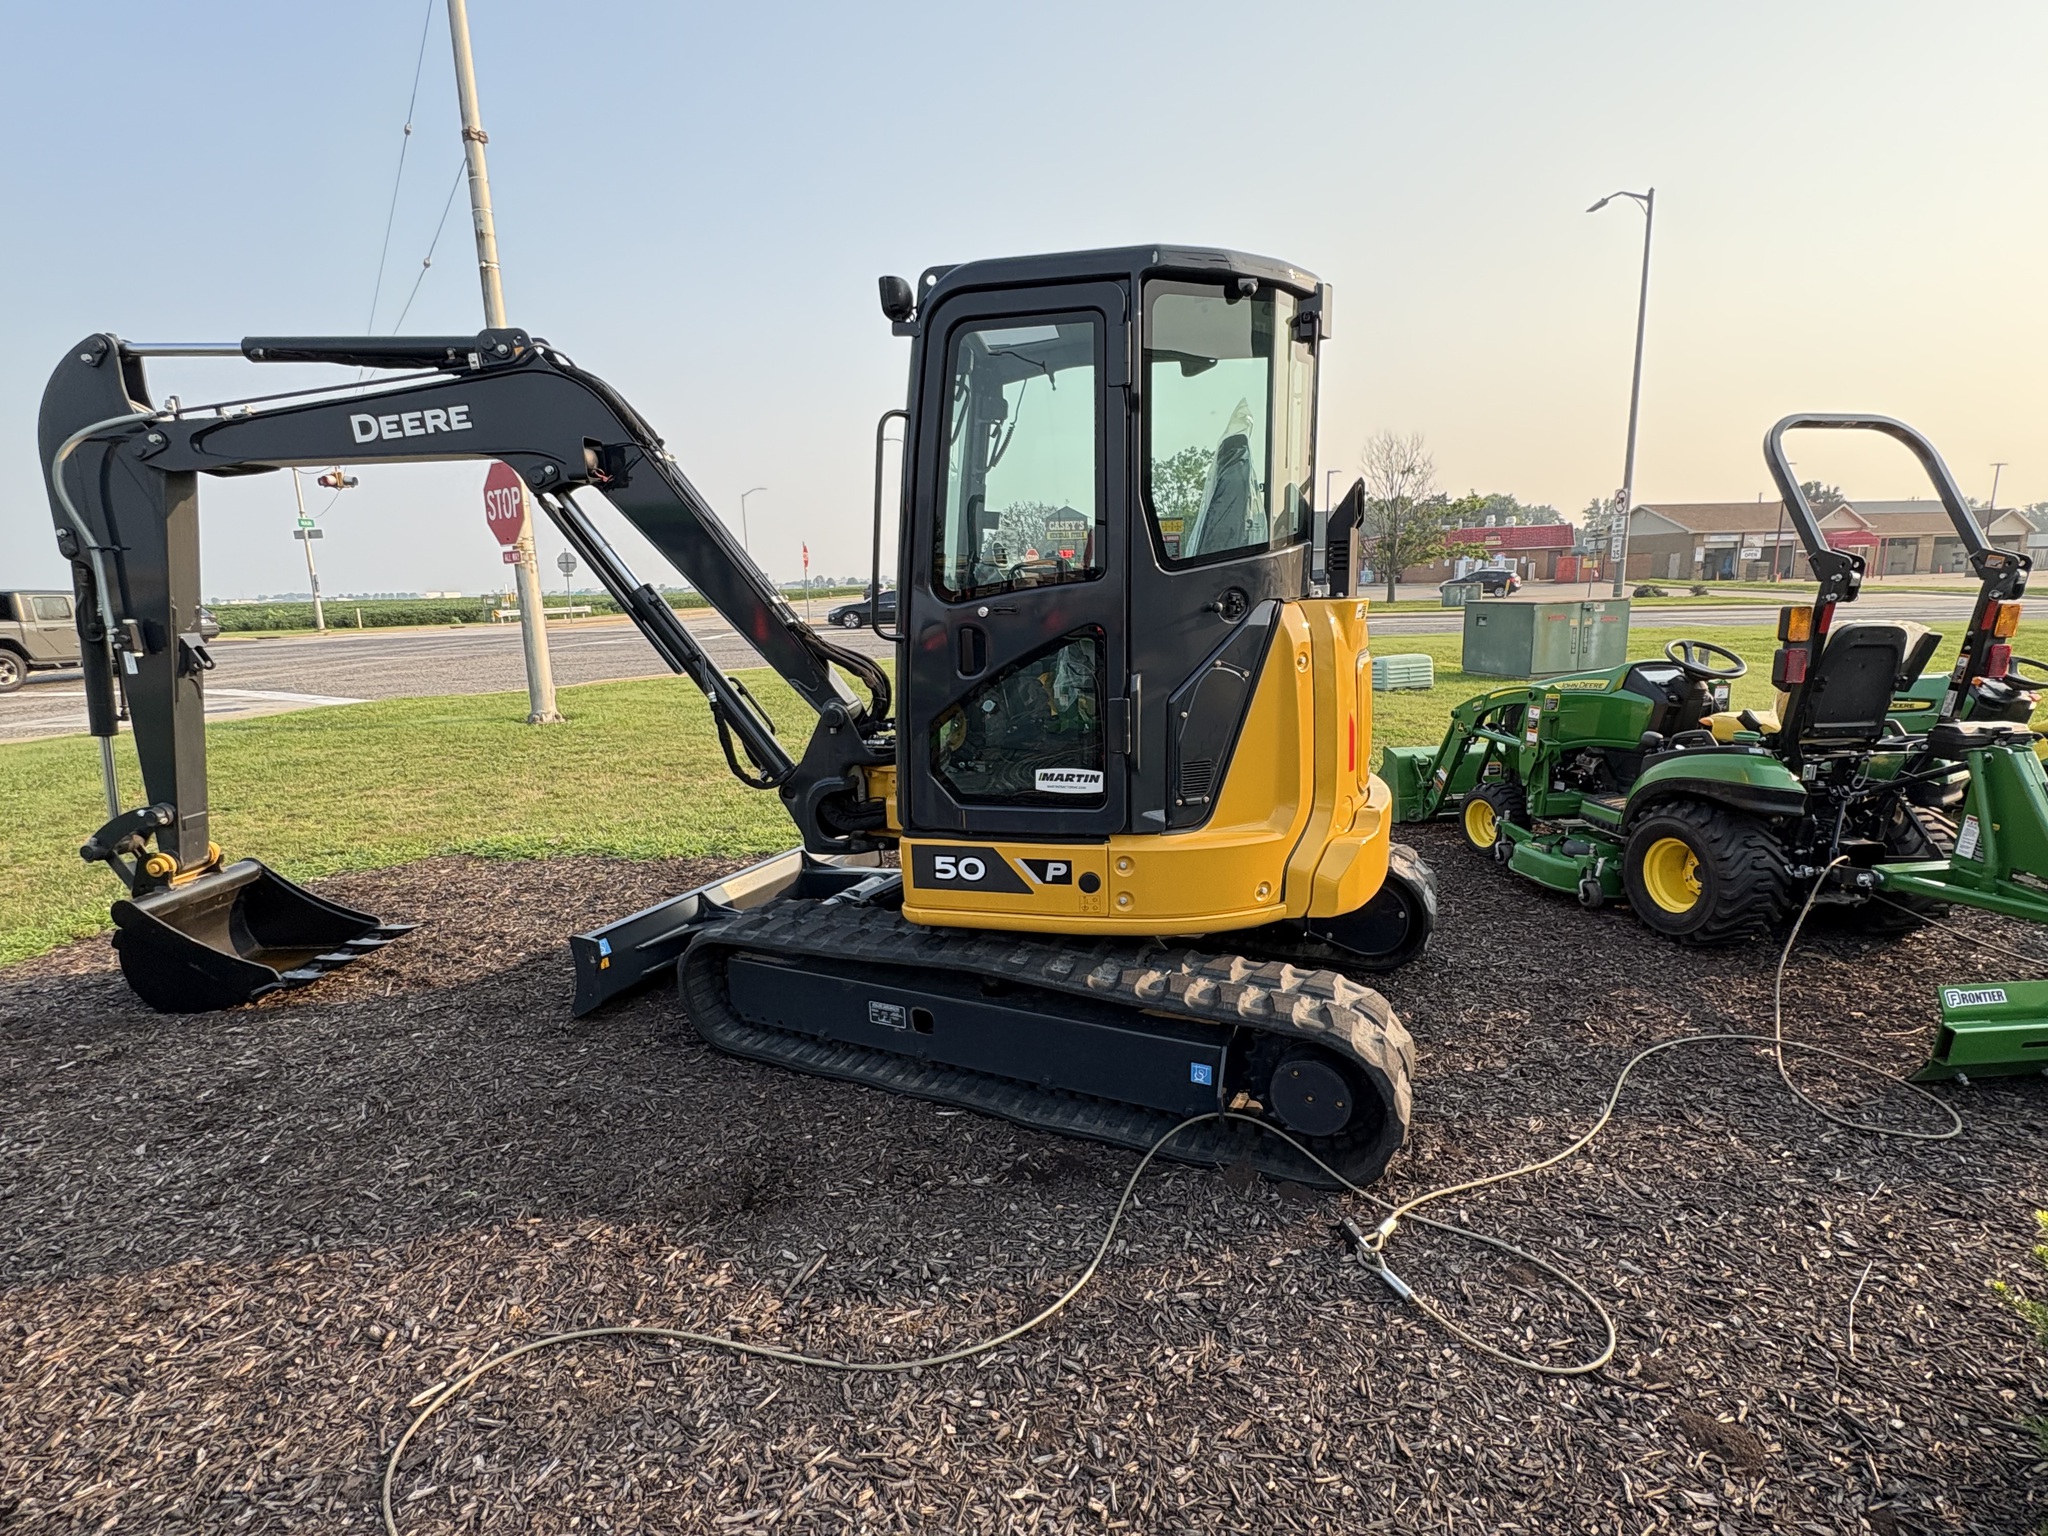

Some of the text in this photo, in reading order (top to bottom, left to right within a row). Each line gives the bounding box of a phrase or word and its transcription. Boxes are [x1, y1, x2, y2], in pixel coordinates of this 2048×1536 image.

[350, 404, 473, 444] DEERE
[487, 486, 520, 521] STOP
[1048, 520, 1085, 531] CASEY'S
[1579, 681, 1605, 689] DEERE
[1038, 772, 1101, 783] MARTIN
[935, 856, 986, 881] 50
[1045, 862, 1067, 882] P
[1945, 990, 2005, 1007] FRONTIER
